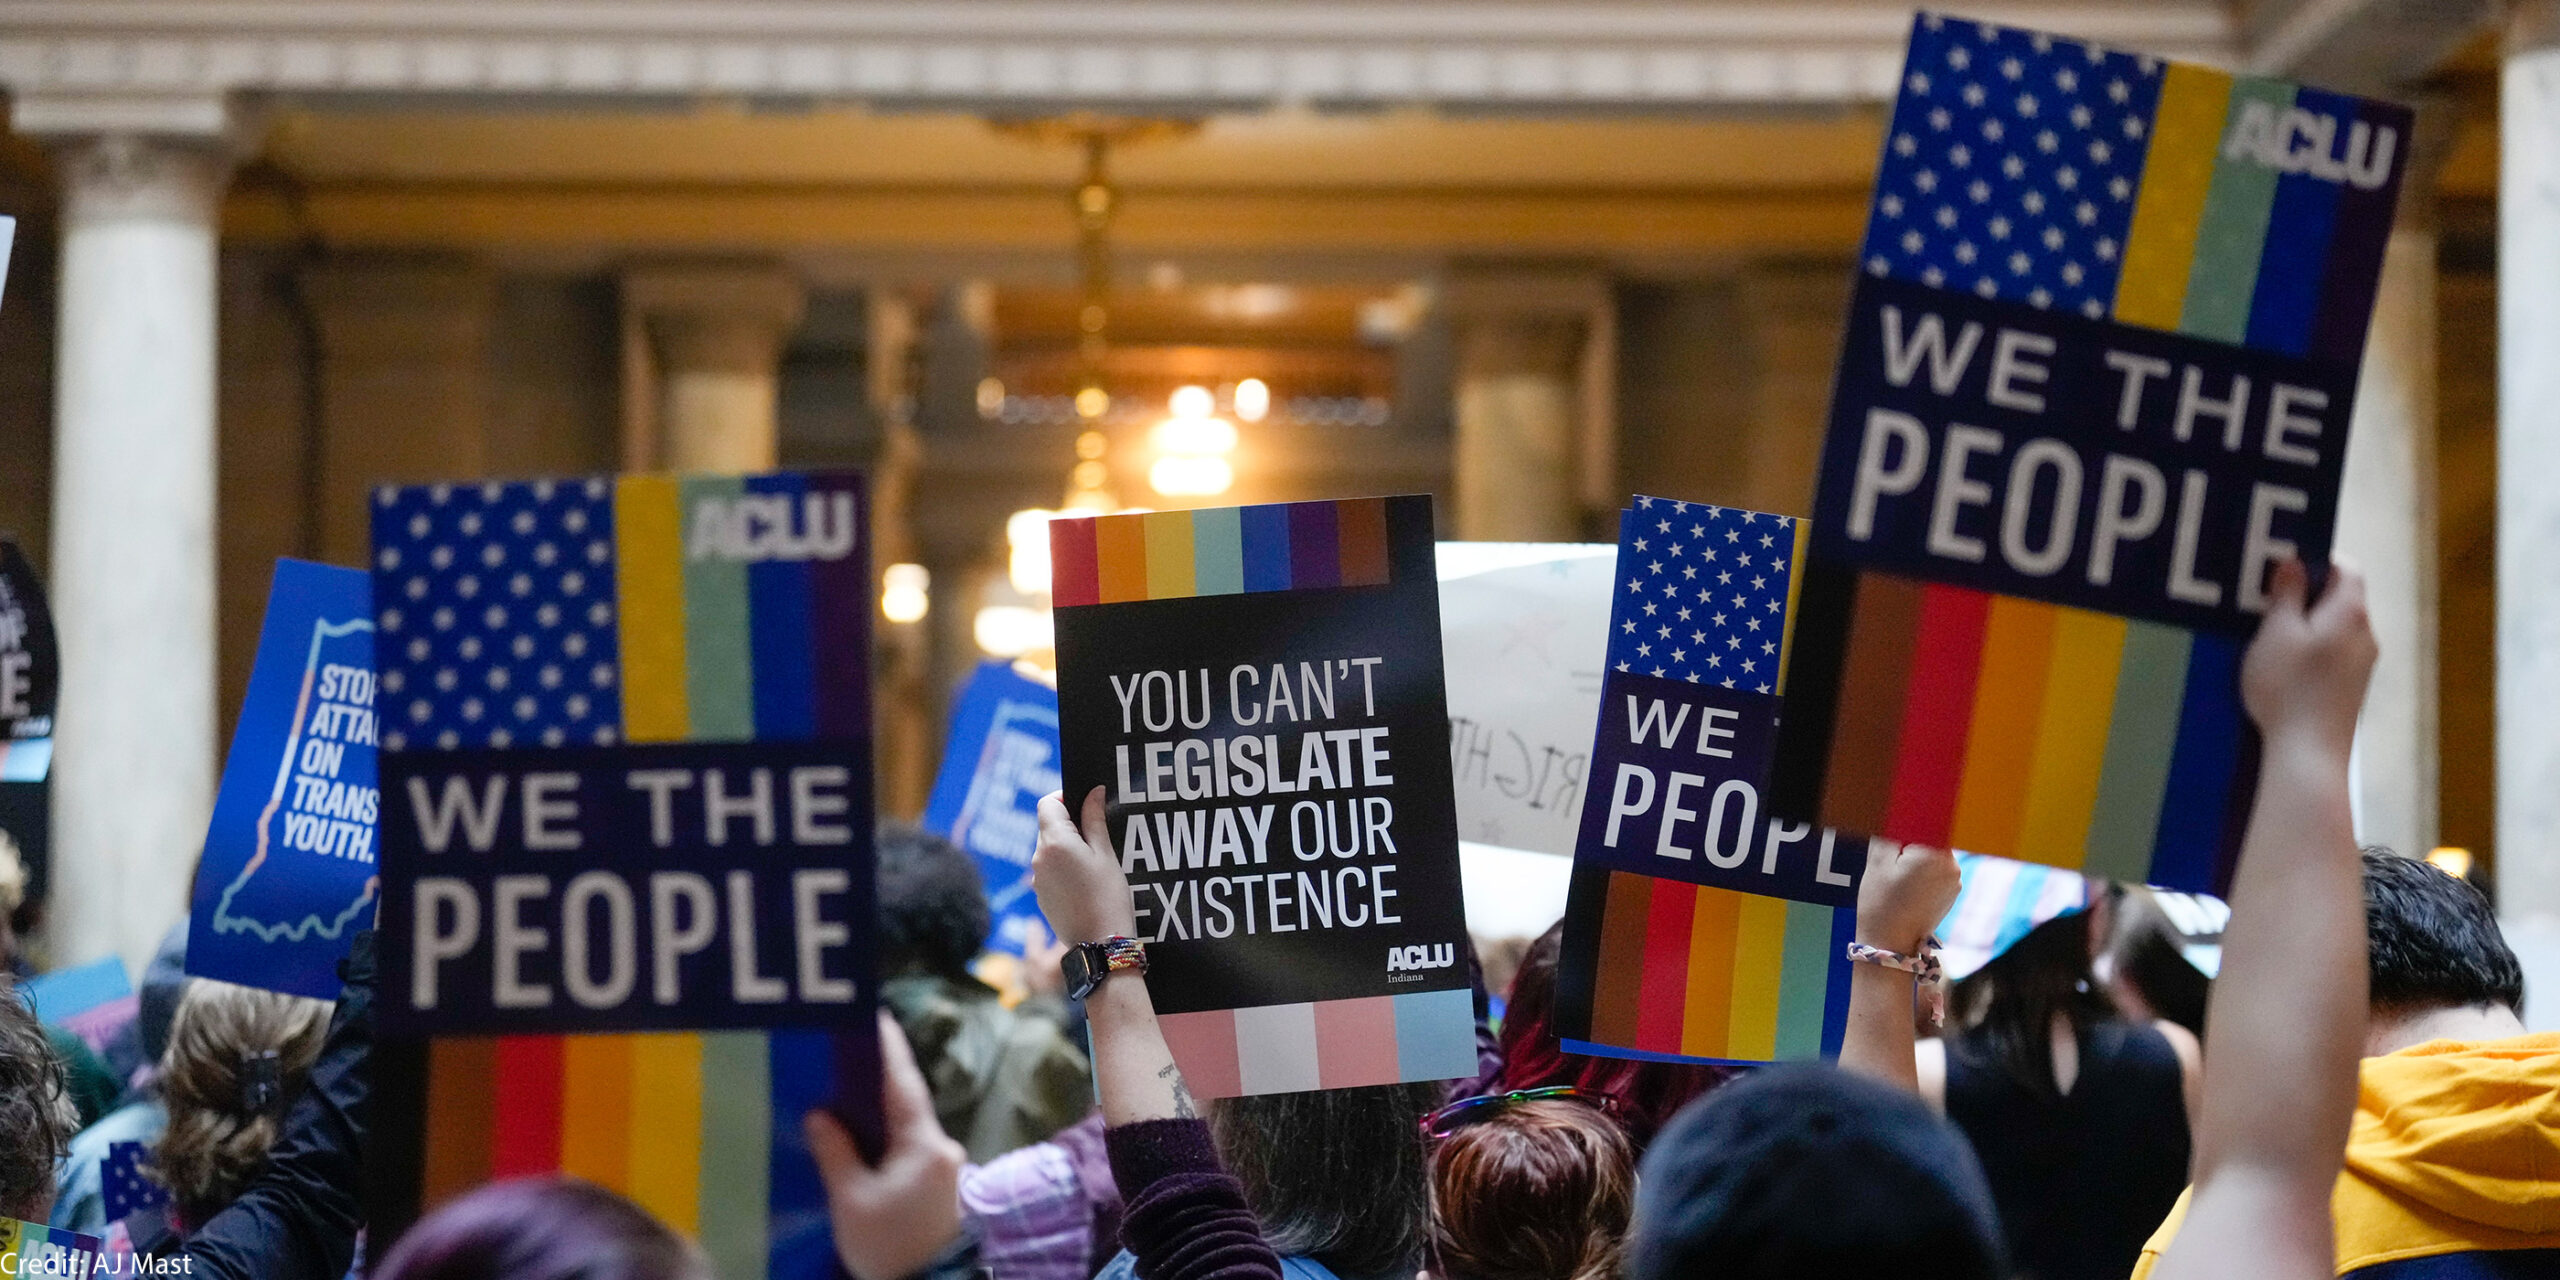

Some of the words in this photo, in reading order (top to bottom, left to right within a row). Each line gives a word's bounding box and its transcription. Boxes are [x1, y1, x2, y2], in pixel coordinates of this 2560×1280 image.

[2224, 98, 2397, 190] ACLU
[1880, 304, 2057, 414] WE
[2104, 349, 2329, 466] THE
[689, 491, 856, 561] ACLU
[1845, 406, 2309, 613] PEOPLE
[1110, 669, 1211, 733] YOU
[1229, 657, 1382, 726] CAN'T
[1627, 694, 1739, 759] WE
[300, 738, 345, 778] ON
[1116, 727, 1393, 804] LEGISLATE
[283, 811, 374, 864] YOUTH.
[292, 774, 380, 825] TRANS
[406, 771, 583, 852] WE
[624, 766, 852, 848] THE
[1121, 804, 1275, 873] AWAY
[1290, 797, 1397, 861] OUR
[411, 869, 856, 1010] PEOPLE
[1129, 865, 1401, 944] EXISTENCE
[1387, 942, 1454, 971] ACLU
[1387, 973, 1424, 983] Indiana
